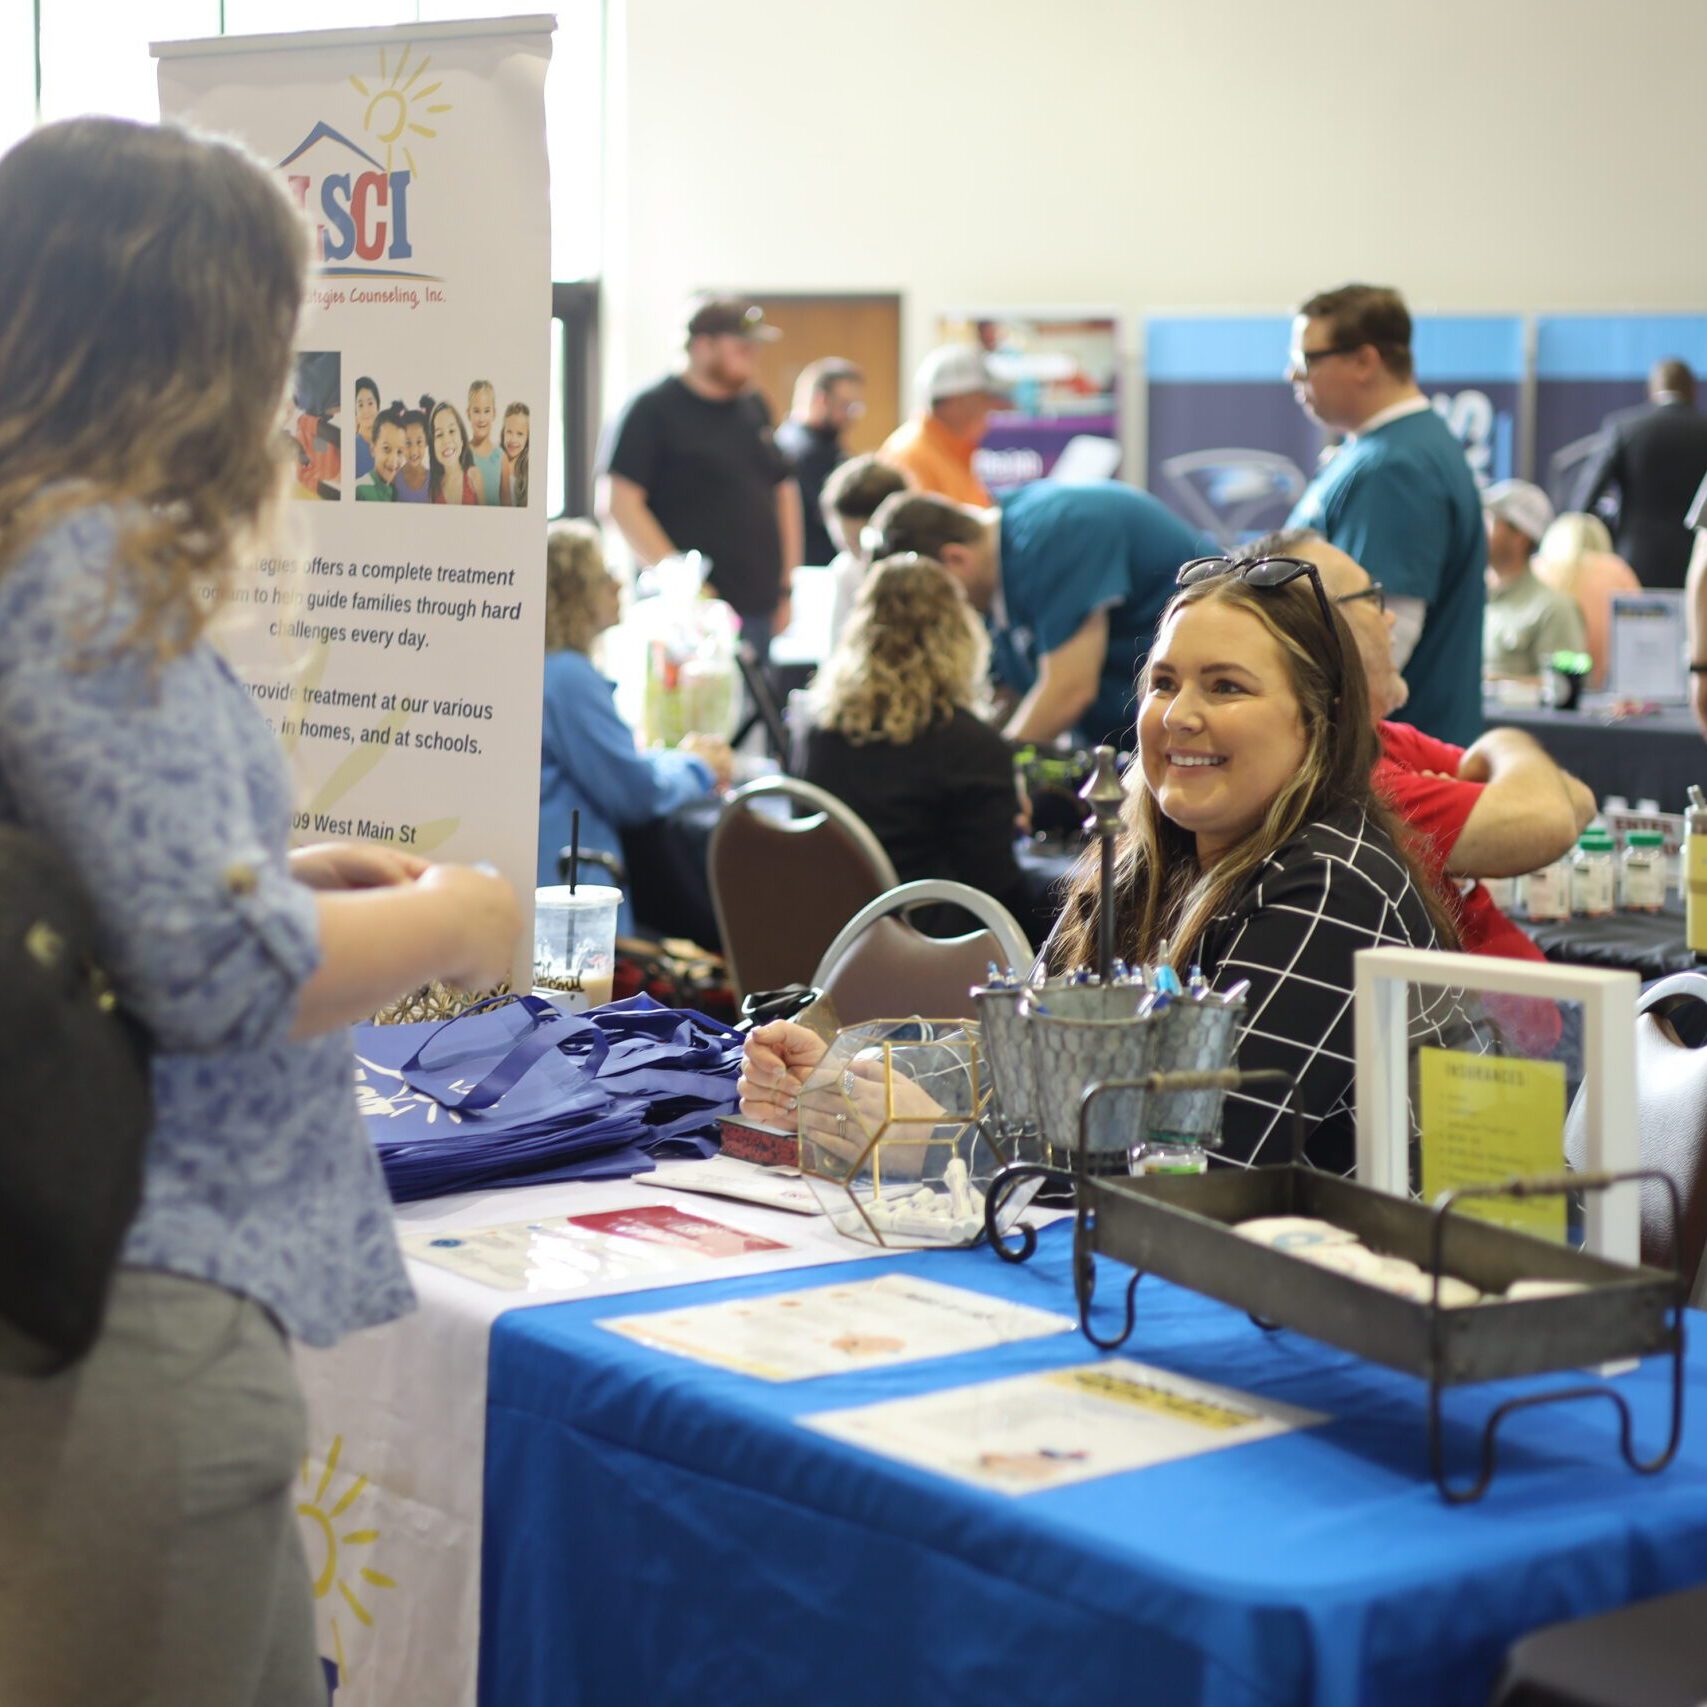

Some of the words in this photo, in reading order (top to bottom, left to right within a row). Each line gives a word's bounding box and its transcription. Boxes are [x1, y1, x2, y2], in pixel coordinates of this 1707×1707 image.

[313, 287, 346, 311] tegies
[425, 286, 447, 304] Inc.
[255, 556, 297, 577] tegies
[304, 556, 343, 577] offers
[348, 562, 357, 577] a
[361, 561, 432, 584] complete
[437, 565, 515, 587] treatment
[254, 587, 268, 603] to
[272, 586, 303, 608] help
[307, 589, 347, 611] guide
[352, 591, 412, 614] families
[416, 596, 476, 622] through
[481, 599, 522, 621] hard
[269, 617, 347, 645] challenges
[351, 627, 394, 650] every
[398, 627, 430, 652] day.
[303, 685, 377, 710] treatment
[381, 693, 396, 711] at
[401, 696, 429, 714] our
[433, 697, 494, 721] various
[281, 716, 295, 735] in
[300, 718, 355, 745] homes,
[360, 726, 391, 745] and
[394, 729, 410, 747] at
[414, 730, 482, 755] schools.
[289, 810, 310, 831] 09
[314, 813, 353, 837] West
[356, 818, 395, 841] Main
[399, 824, 417, 844] St
